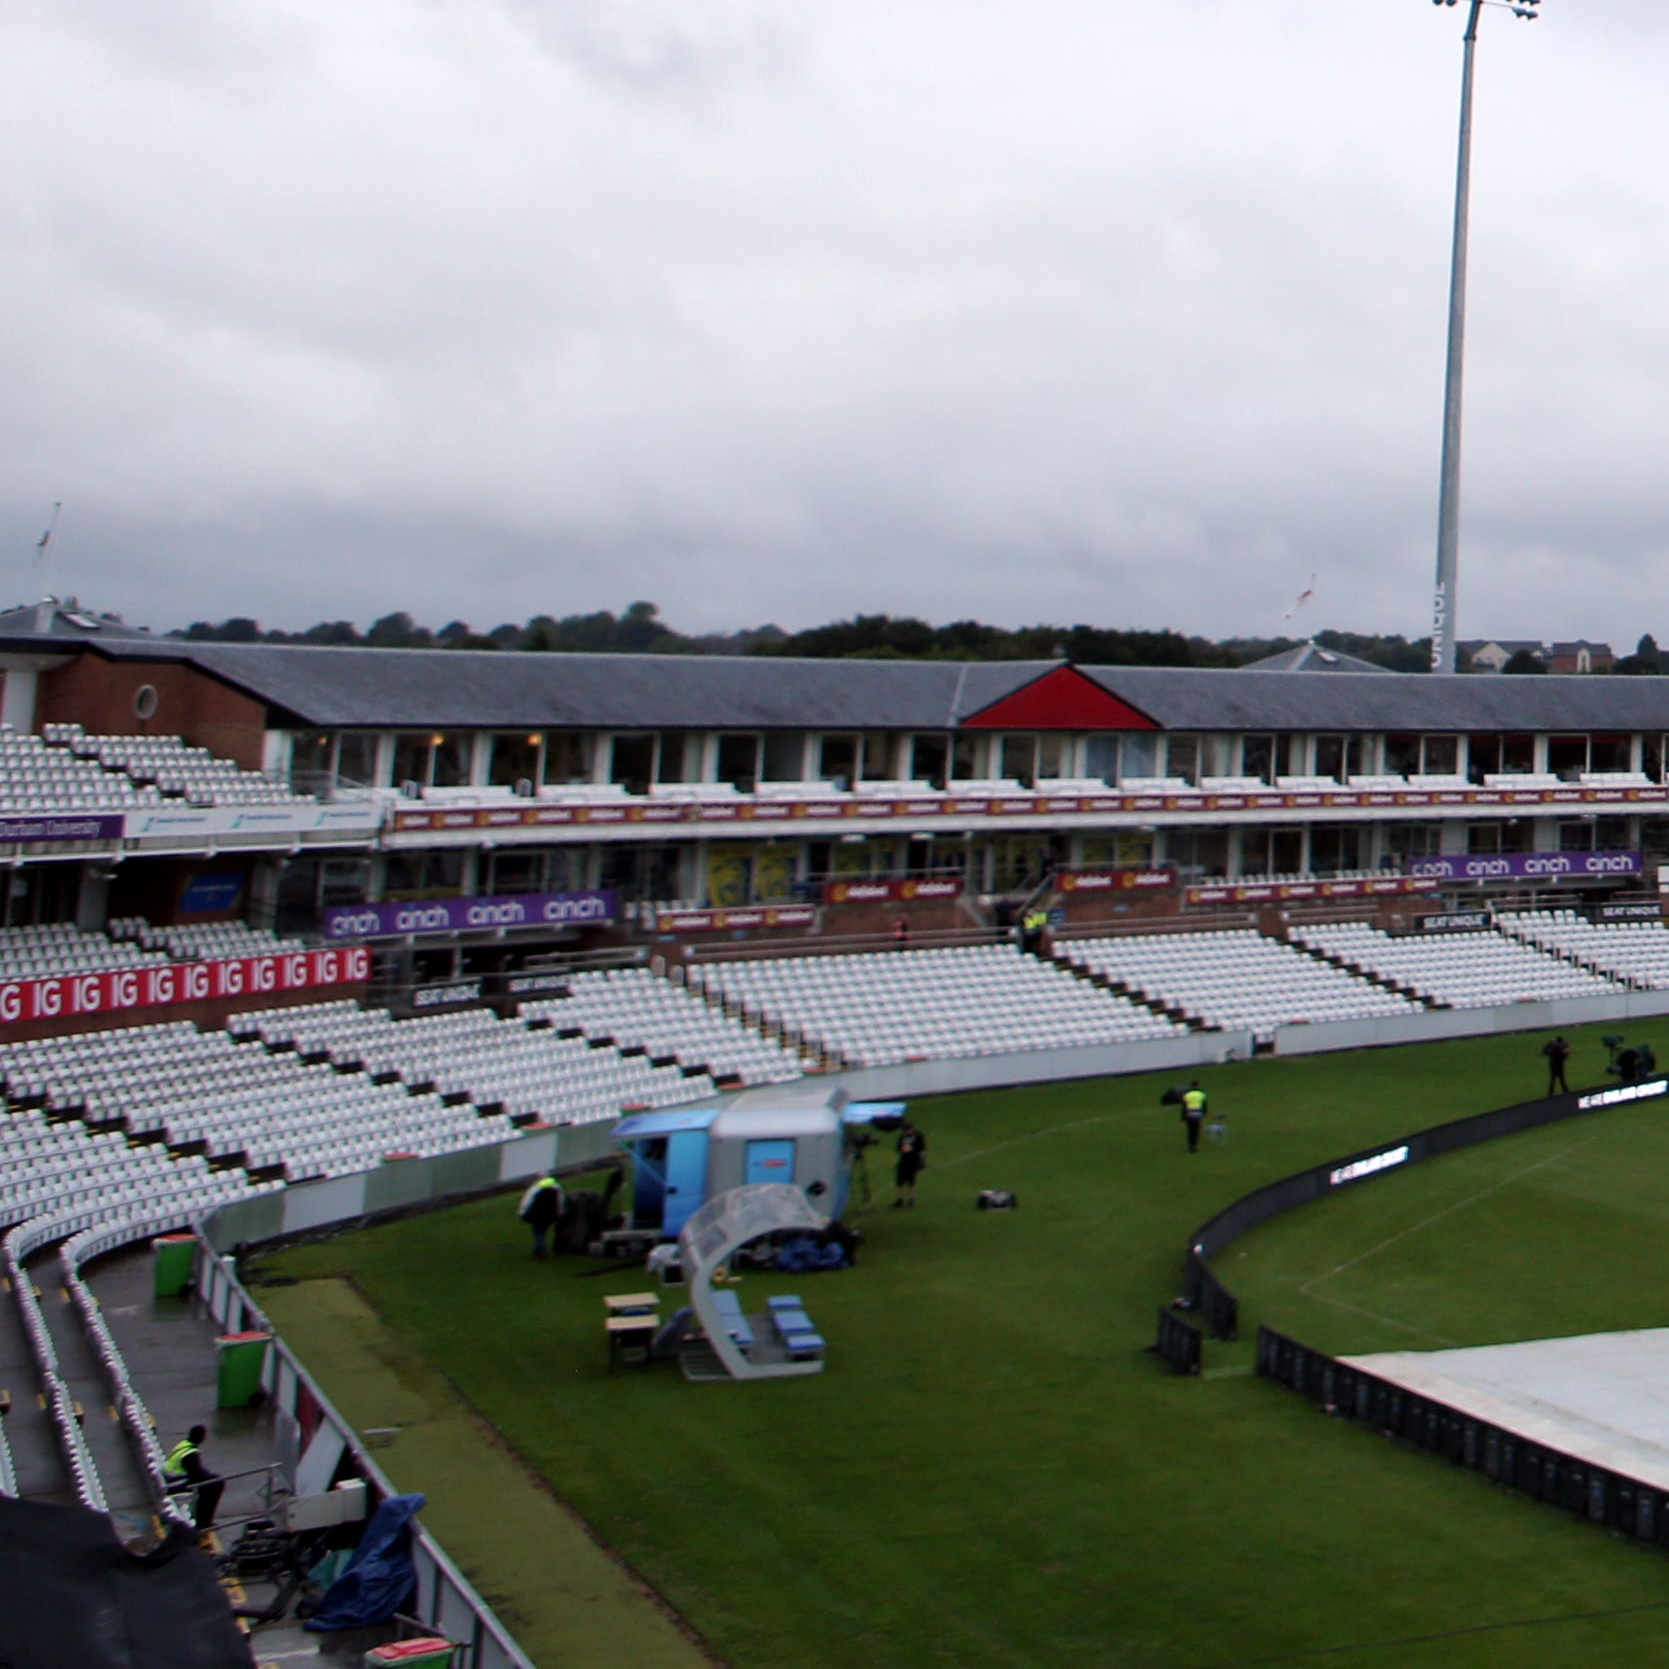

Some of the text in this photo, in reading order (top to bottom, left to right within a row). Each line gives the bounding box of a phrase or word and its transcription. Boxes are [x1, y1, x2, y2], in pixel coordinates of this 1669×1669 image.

[1466, 856, 1510, 875] cinch
[1525, 853, 1570, 873] cinch
[1586, 850, 1632, 872] cinch
[332, 895, 604, 936] cinch cinch cinch cinch
[1626, 904, 1660, 916] UNIQUE
[0, 948, 368, 1021] G IG IG IG IG IG IG IG IG IG IG
